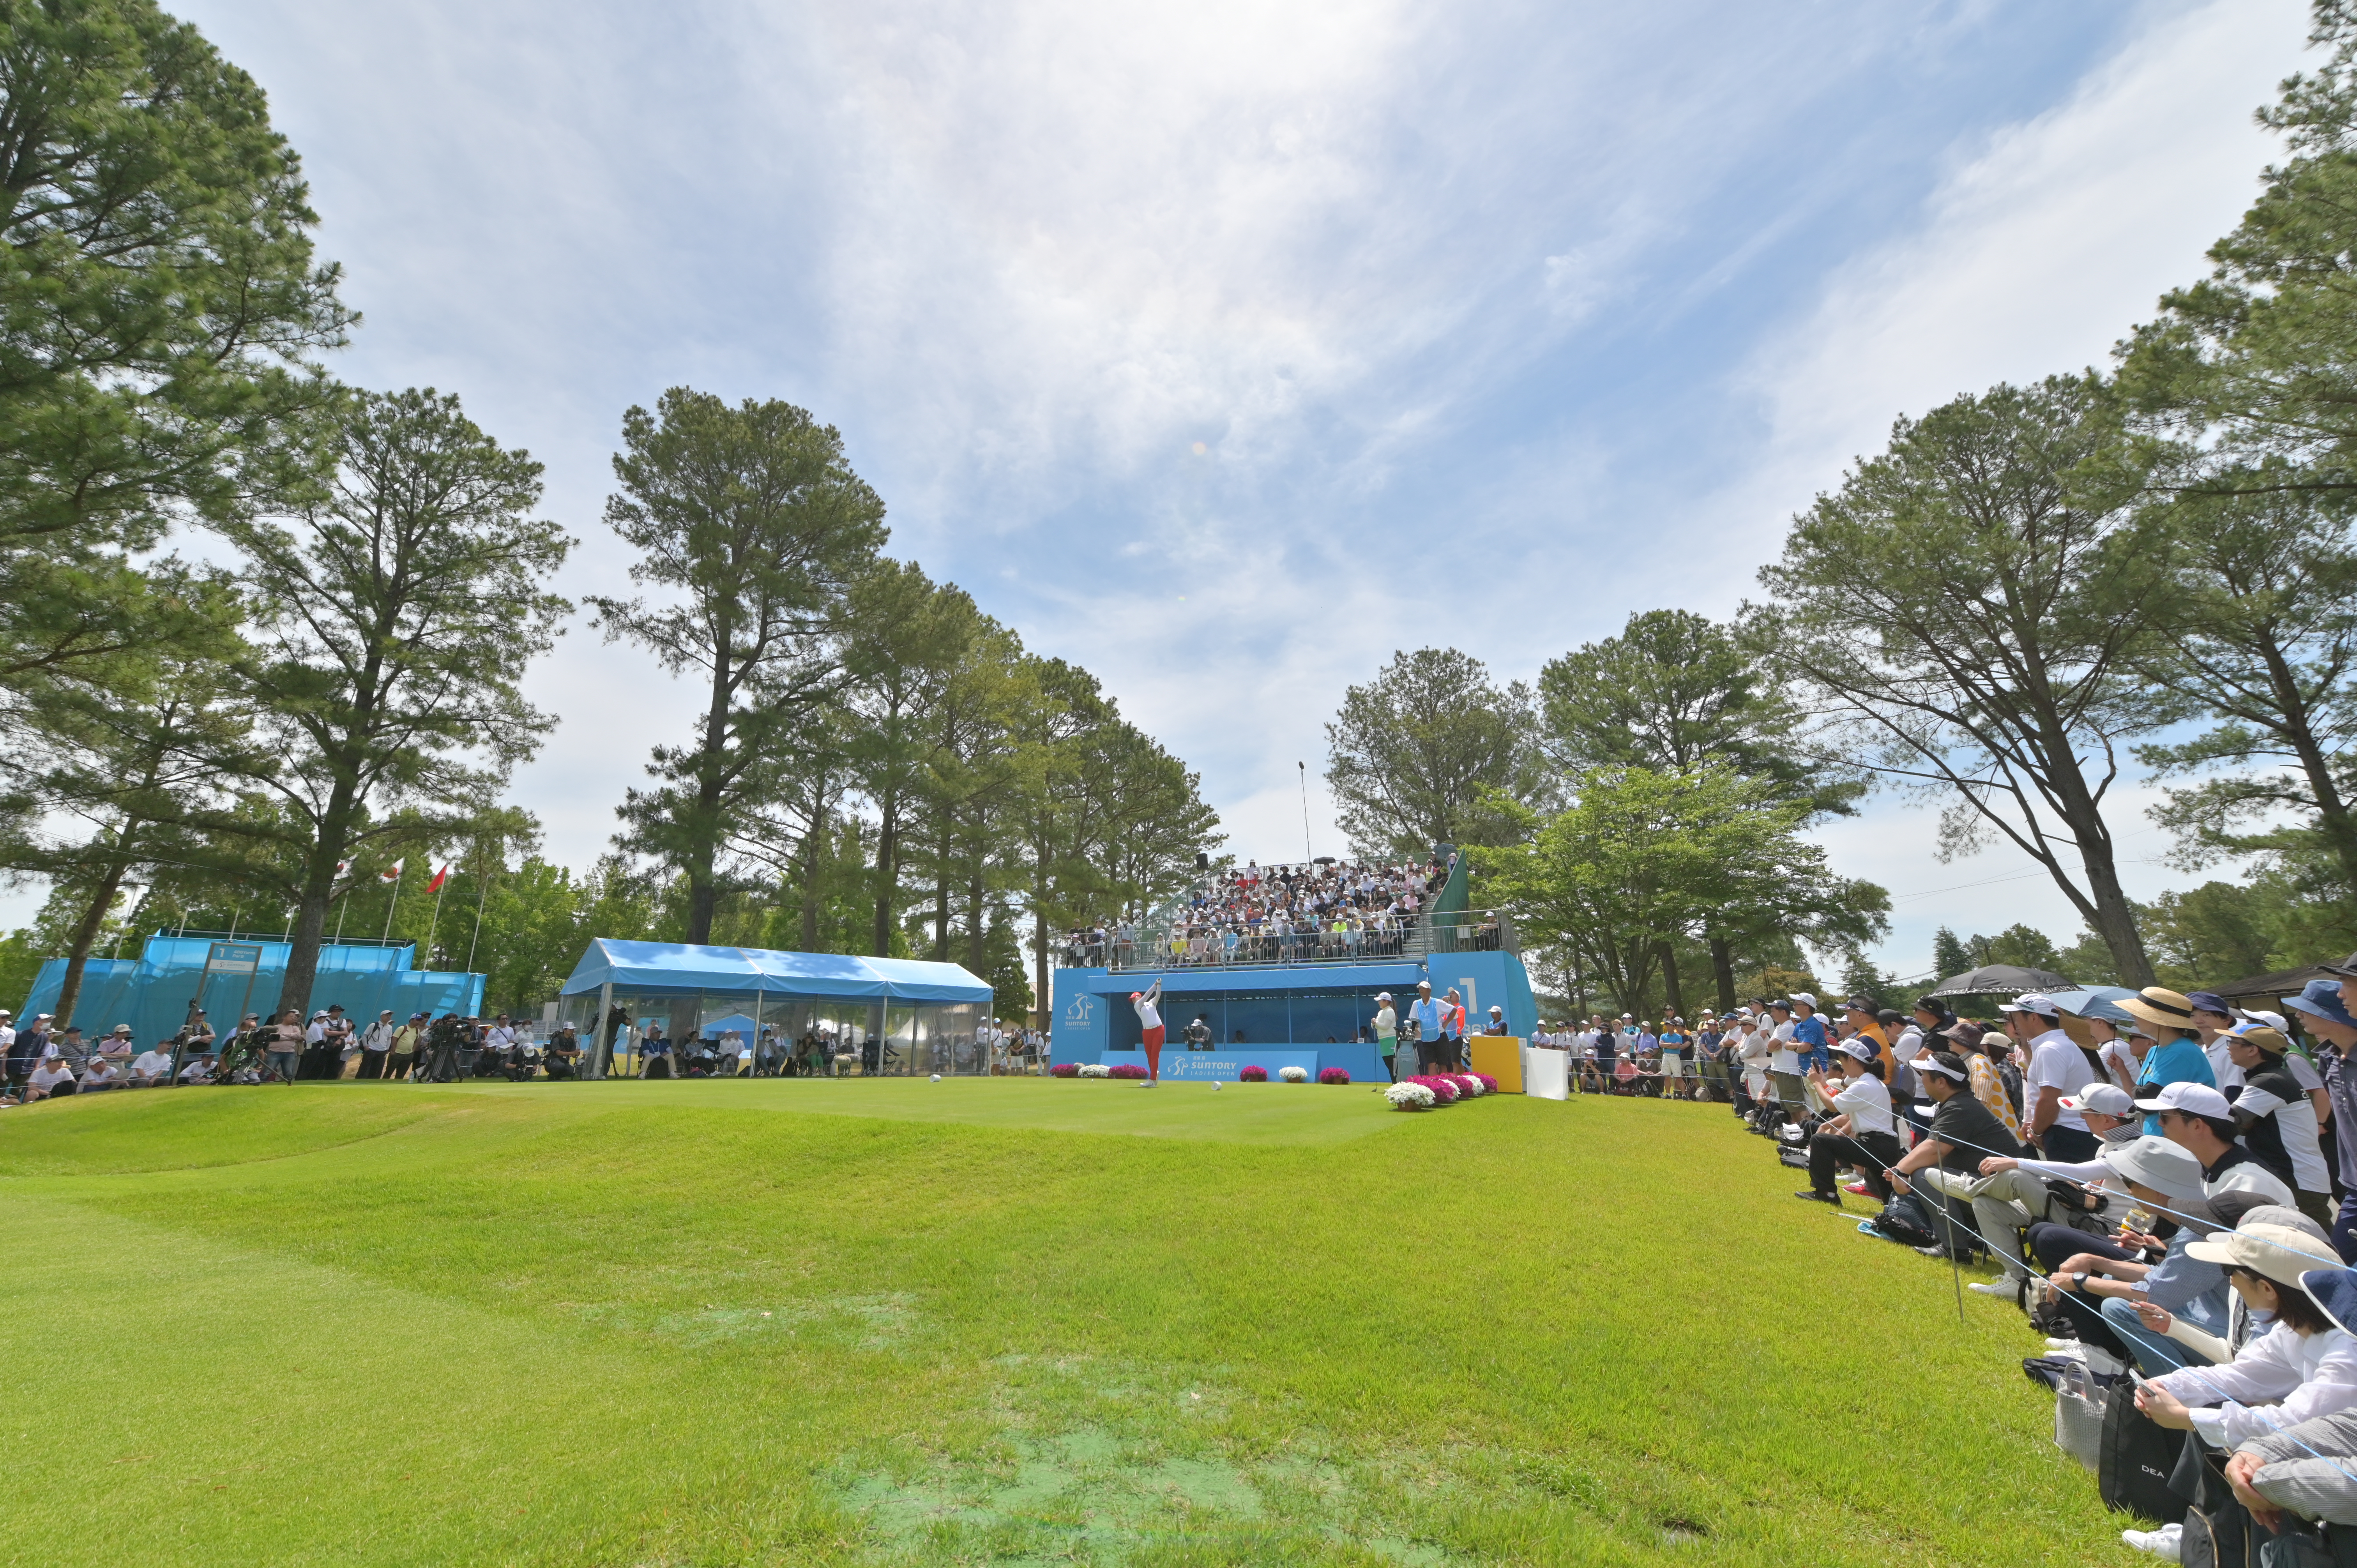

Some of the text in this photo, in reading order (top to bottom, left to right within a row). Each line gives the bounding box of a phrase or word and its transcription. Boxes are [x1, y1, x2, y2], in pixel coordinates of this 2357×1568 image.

[219, 948, 225, 957] 1
[1459, 977, 1477, 1014] 1
[2142, 1465, 2166, 1479] DEA
